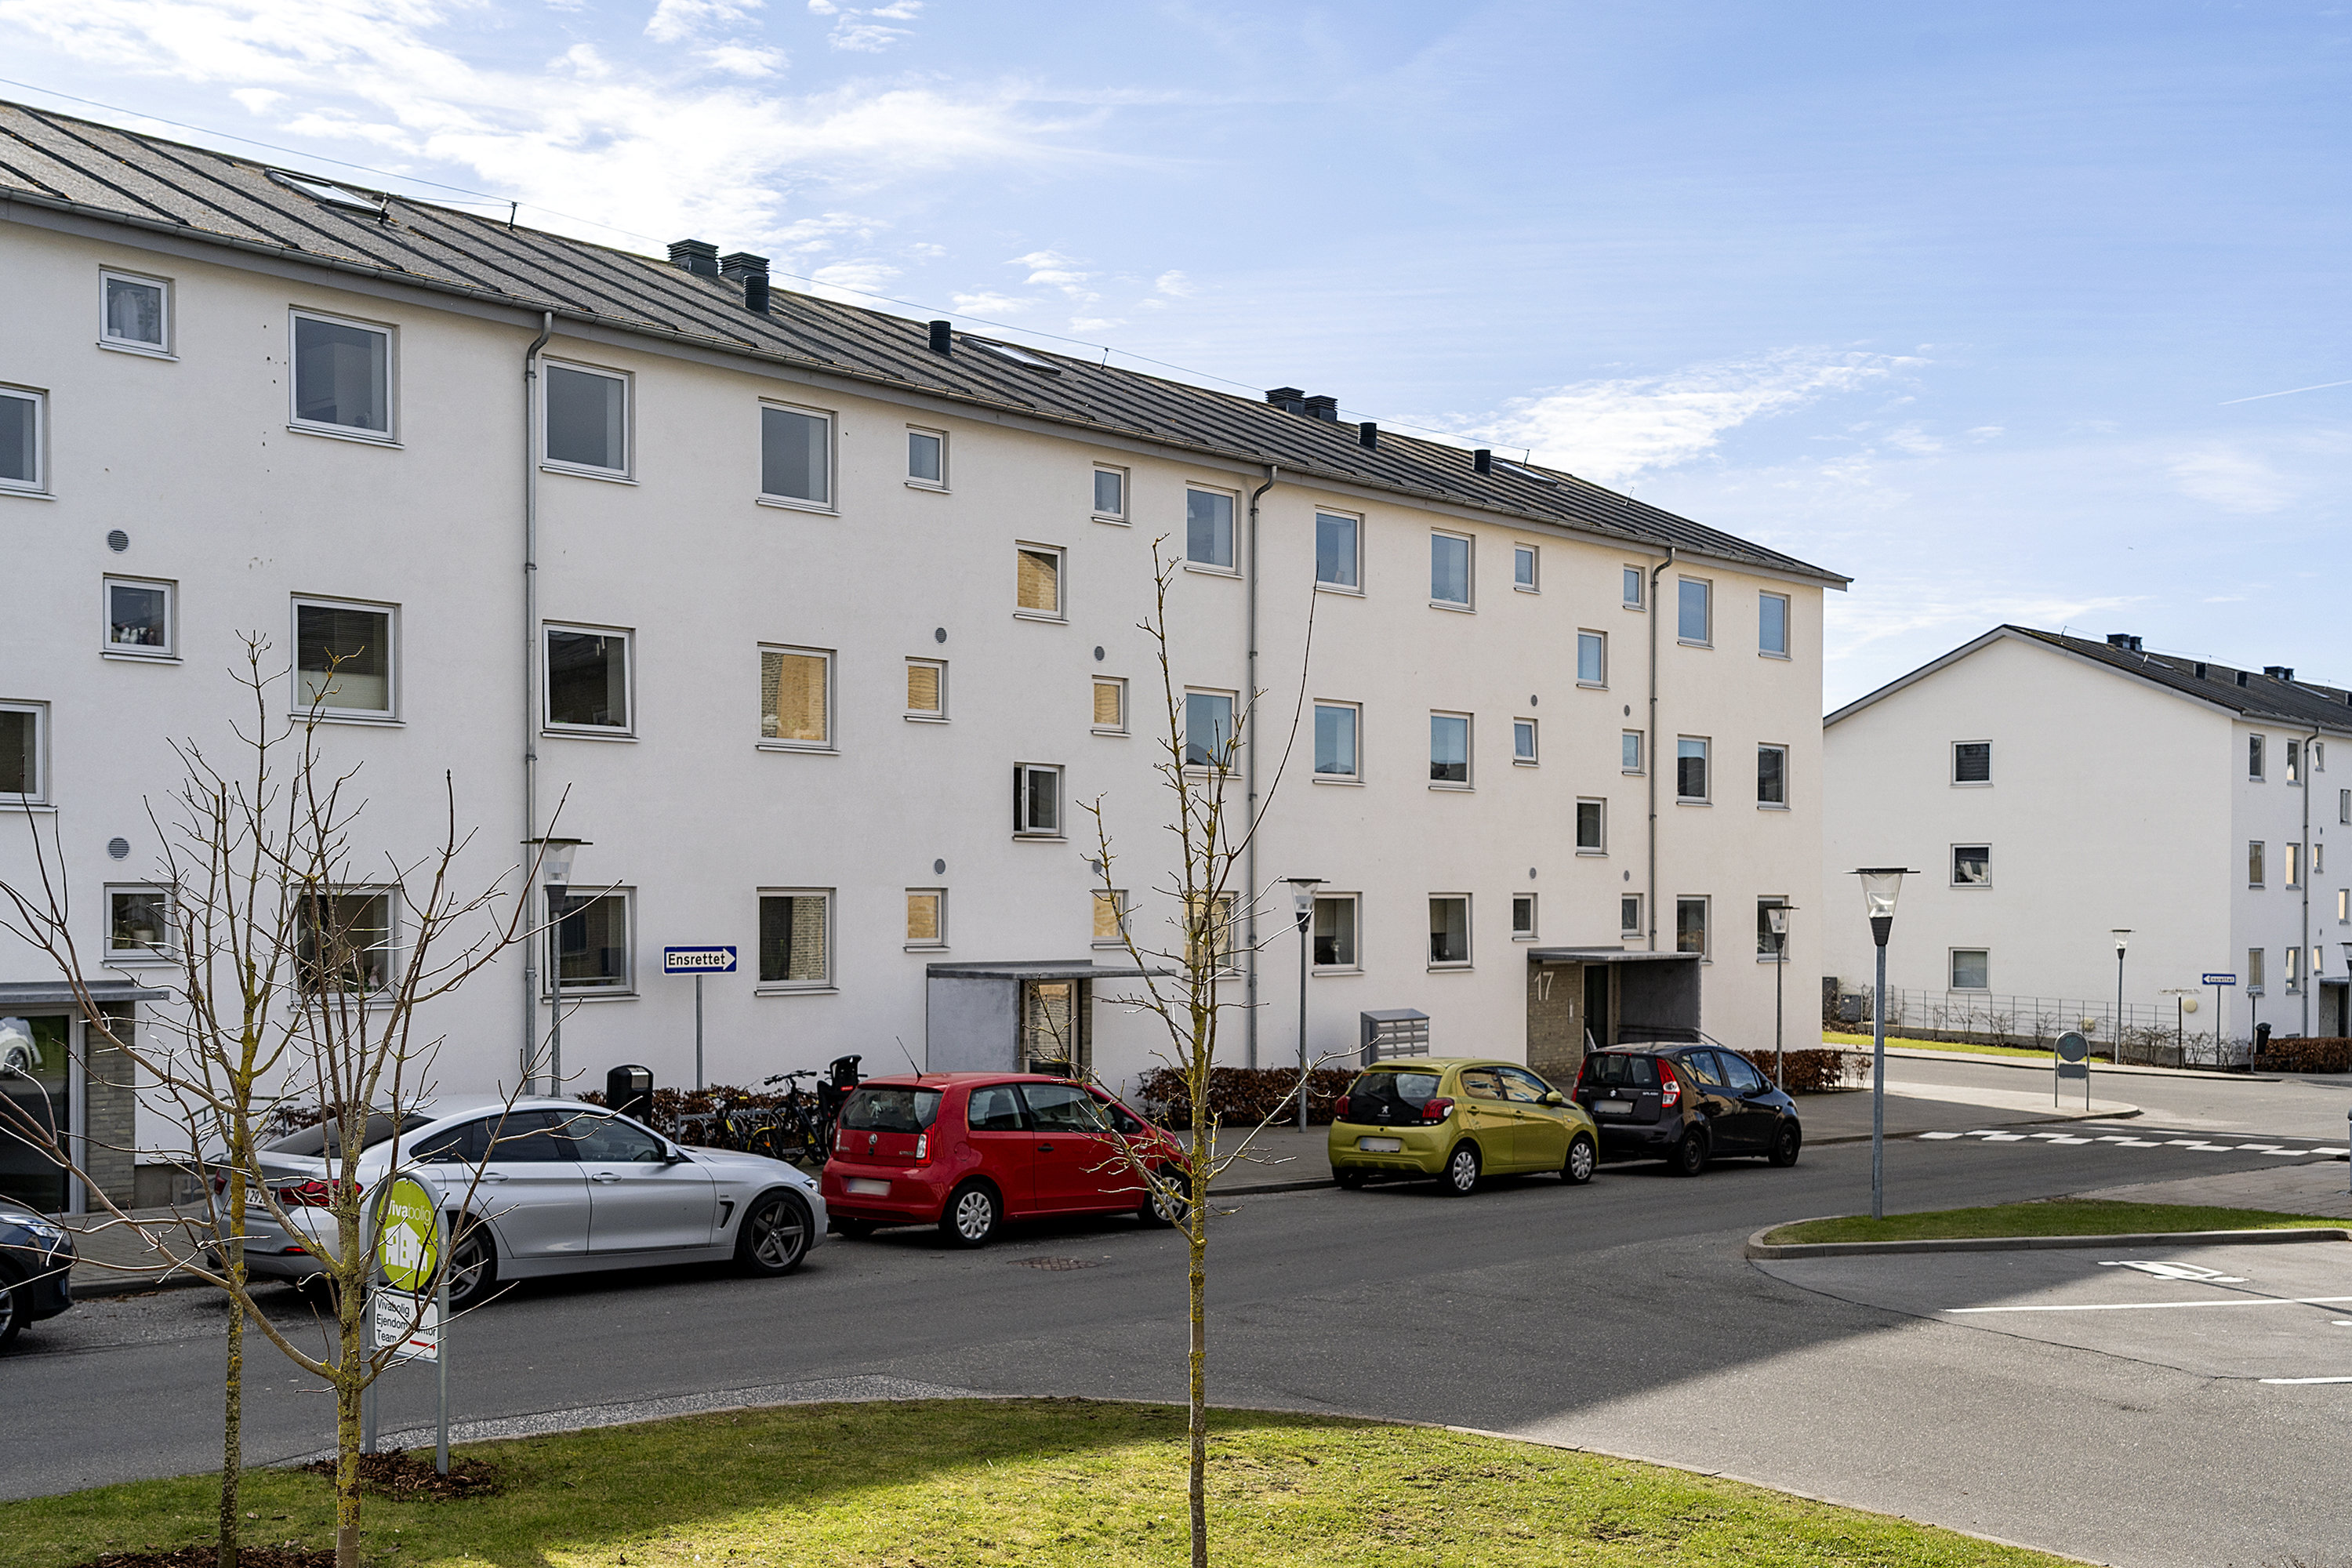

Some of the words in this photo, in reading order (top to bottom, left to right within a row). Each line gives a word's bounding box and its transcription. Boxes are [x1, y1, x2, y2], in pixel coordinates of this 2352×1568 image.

[668, 953, 725, 966] Ensrettet
[1534, 971, 1554, 1000] 17
[377, 1298, 410, 1318] Vivabolig
[376, 1313, 437, 1337] Ejendomntor
[376, 1329, 397, 1343] Team
